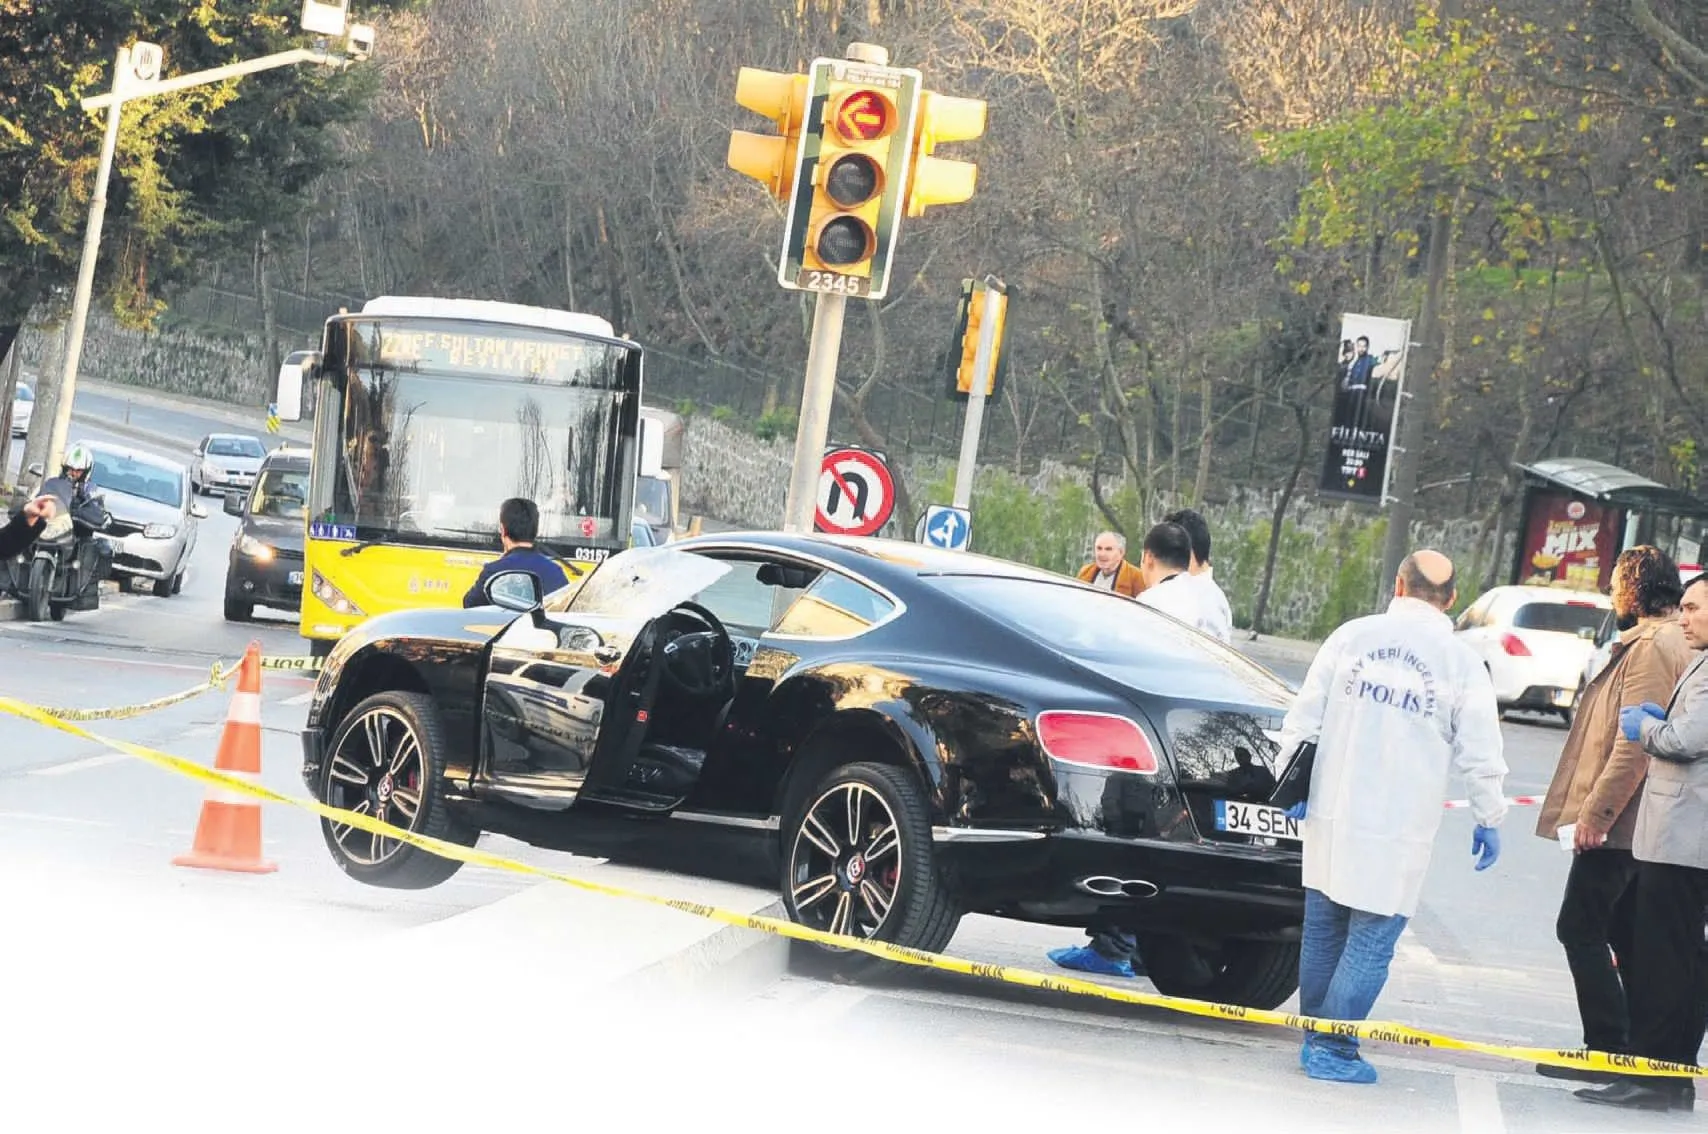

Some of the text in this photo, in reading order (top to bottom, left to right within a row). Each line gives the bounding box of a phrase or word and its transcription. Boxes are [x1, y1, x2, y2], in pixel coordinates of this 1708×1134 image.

[808, 271, 860, 295] 2345
[1359, 680, 1421, 713] POLİS
[1228, 805, 1299, 837] 34 SEN
